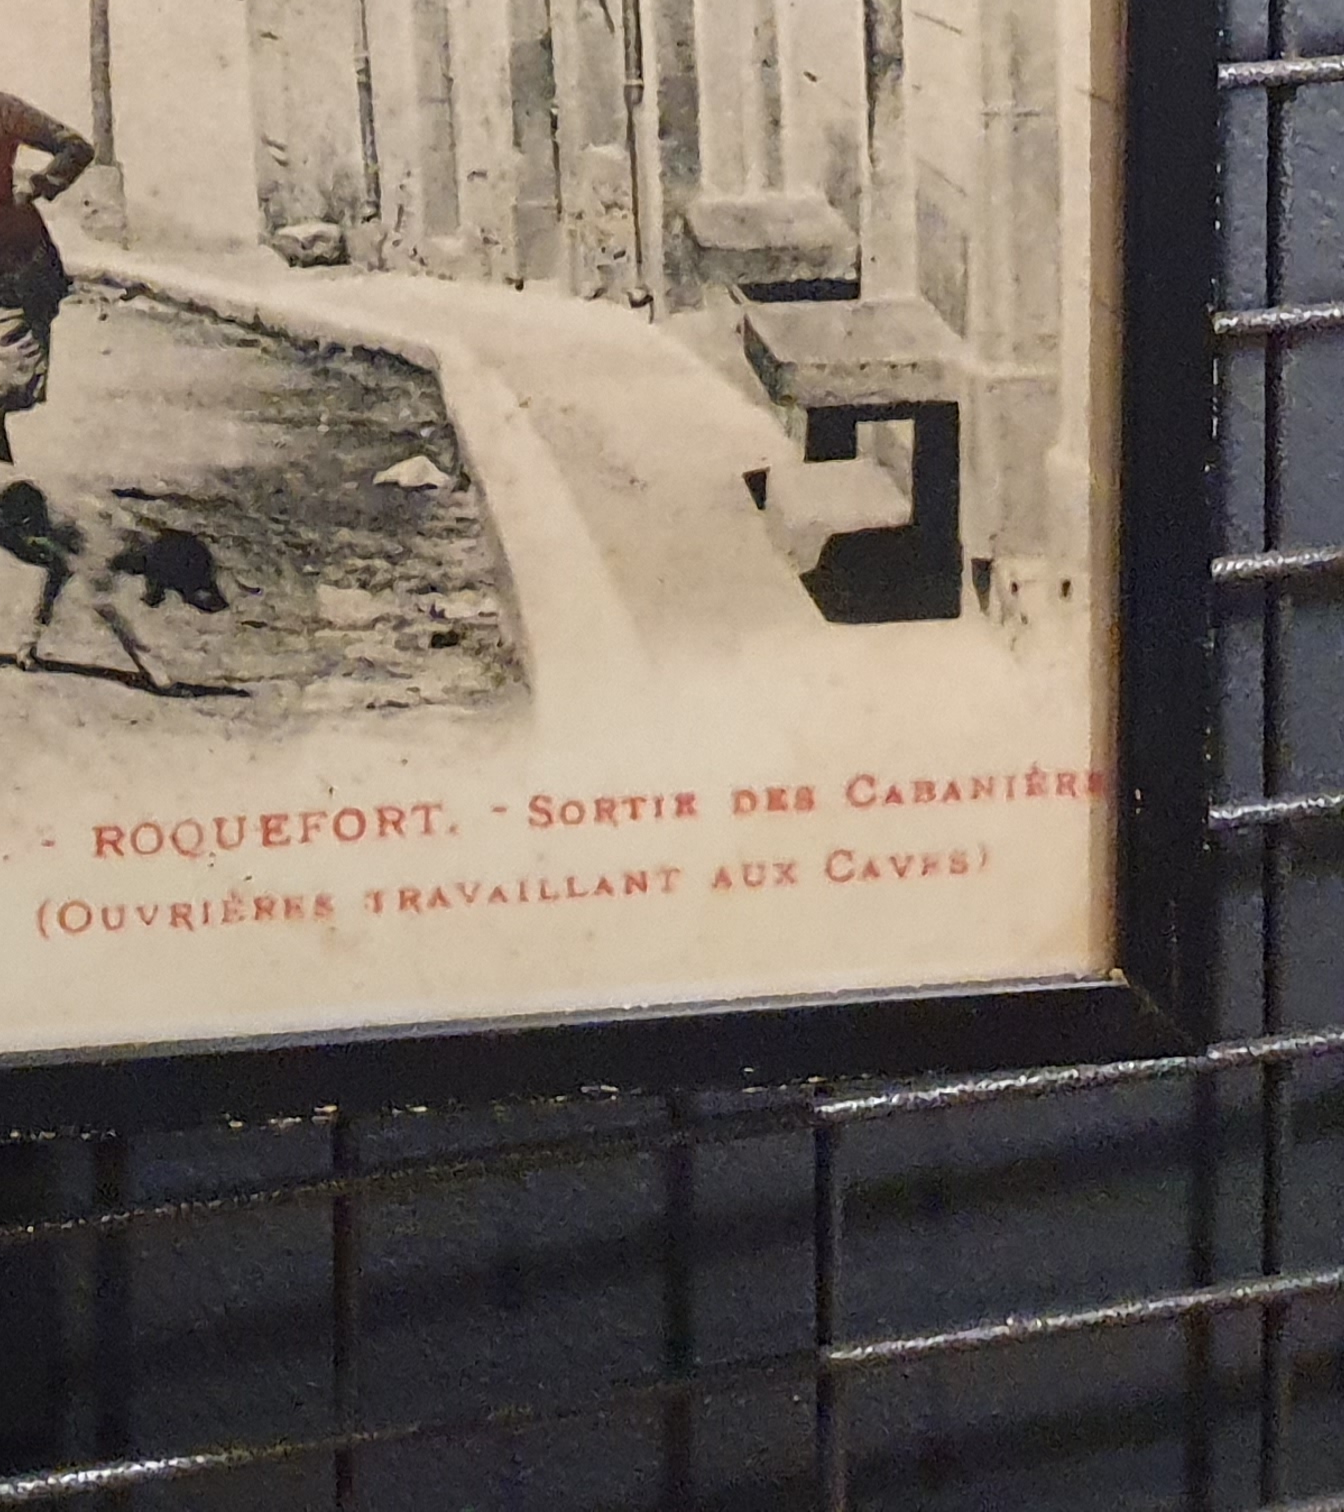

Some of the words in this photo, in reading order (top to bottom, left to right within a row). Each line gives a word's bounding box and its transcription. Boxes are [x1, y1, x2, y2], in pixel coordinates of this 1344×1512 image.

[93, 801, 459, 860] ROQUEFORT.
[732, 785, 820, 816] DES
[712, 862, 797, 890] AUX
